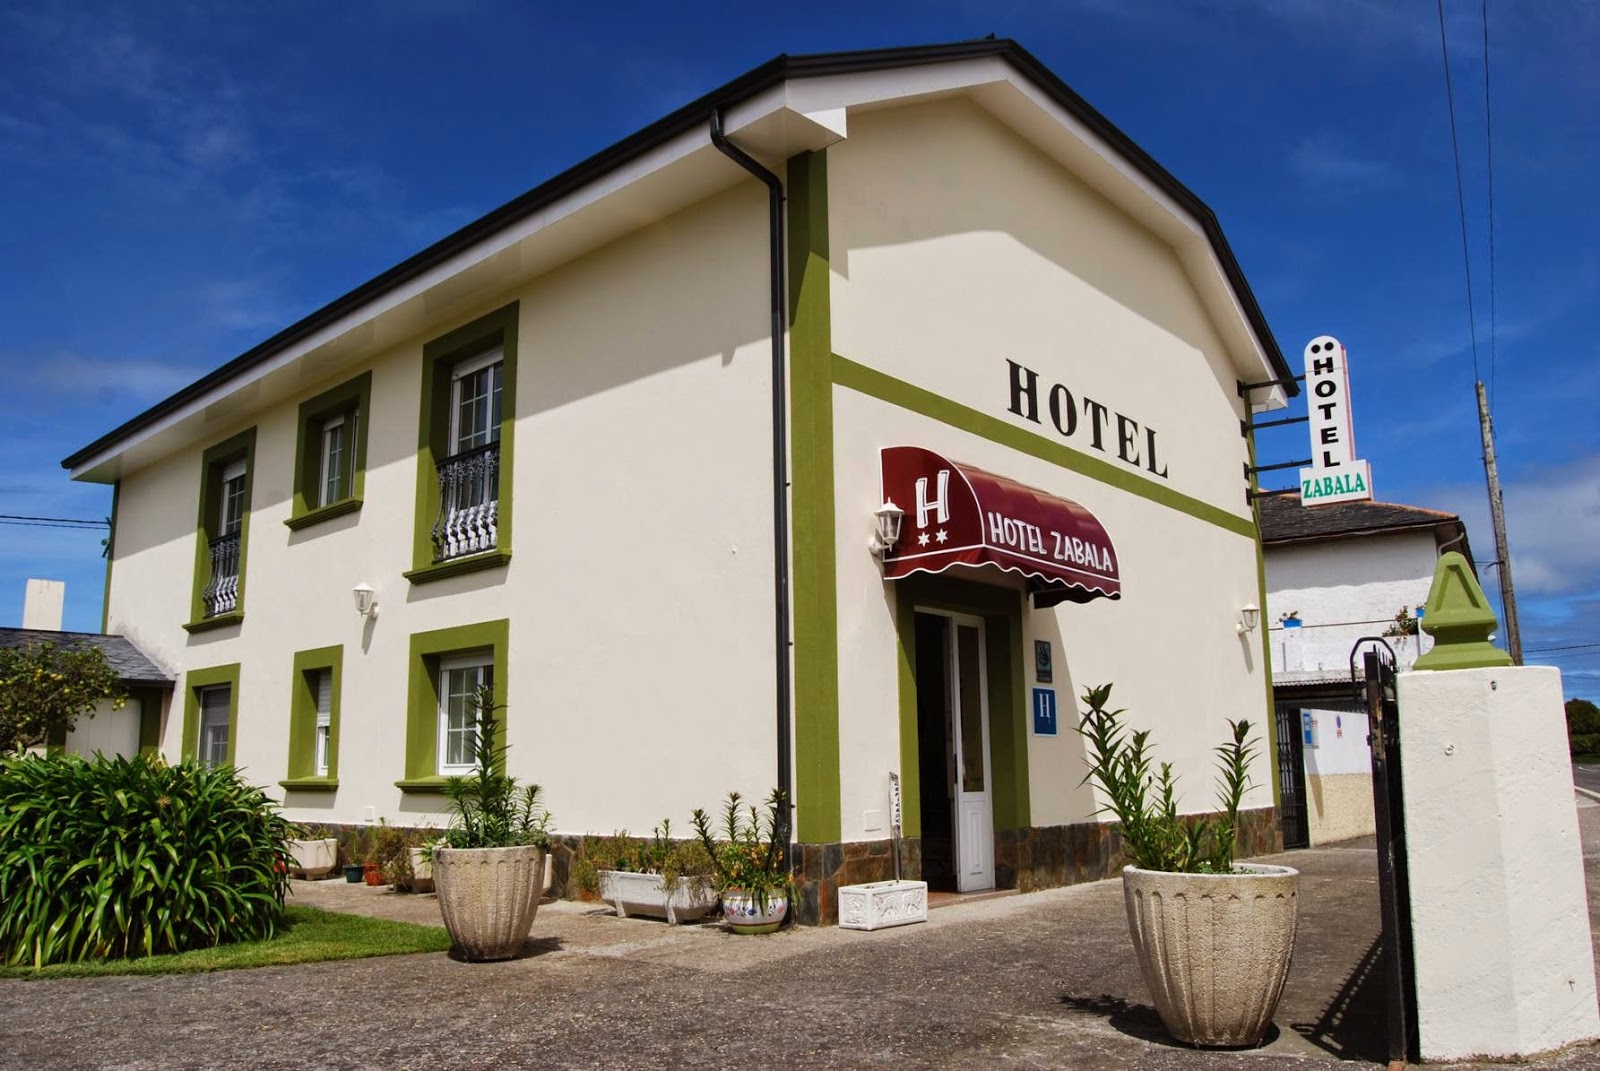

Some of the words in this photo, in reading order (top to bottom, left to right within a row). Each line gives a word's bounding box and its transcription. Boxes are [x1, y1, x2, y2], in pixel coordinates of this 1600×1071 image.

[1005, 358, 1169, 480] HOTEL
[1313, 356, 1340, 468] HOTEL
[915, 470, 950, 529] H
[1302, 472, 1367, 499] ZABALA
[988, 512, 1048, 555] HOTEL
[1050, 530, 1114, 573] ZABALA
[1038, 693, 1052, 718] H
